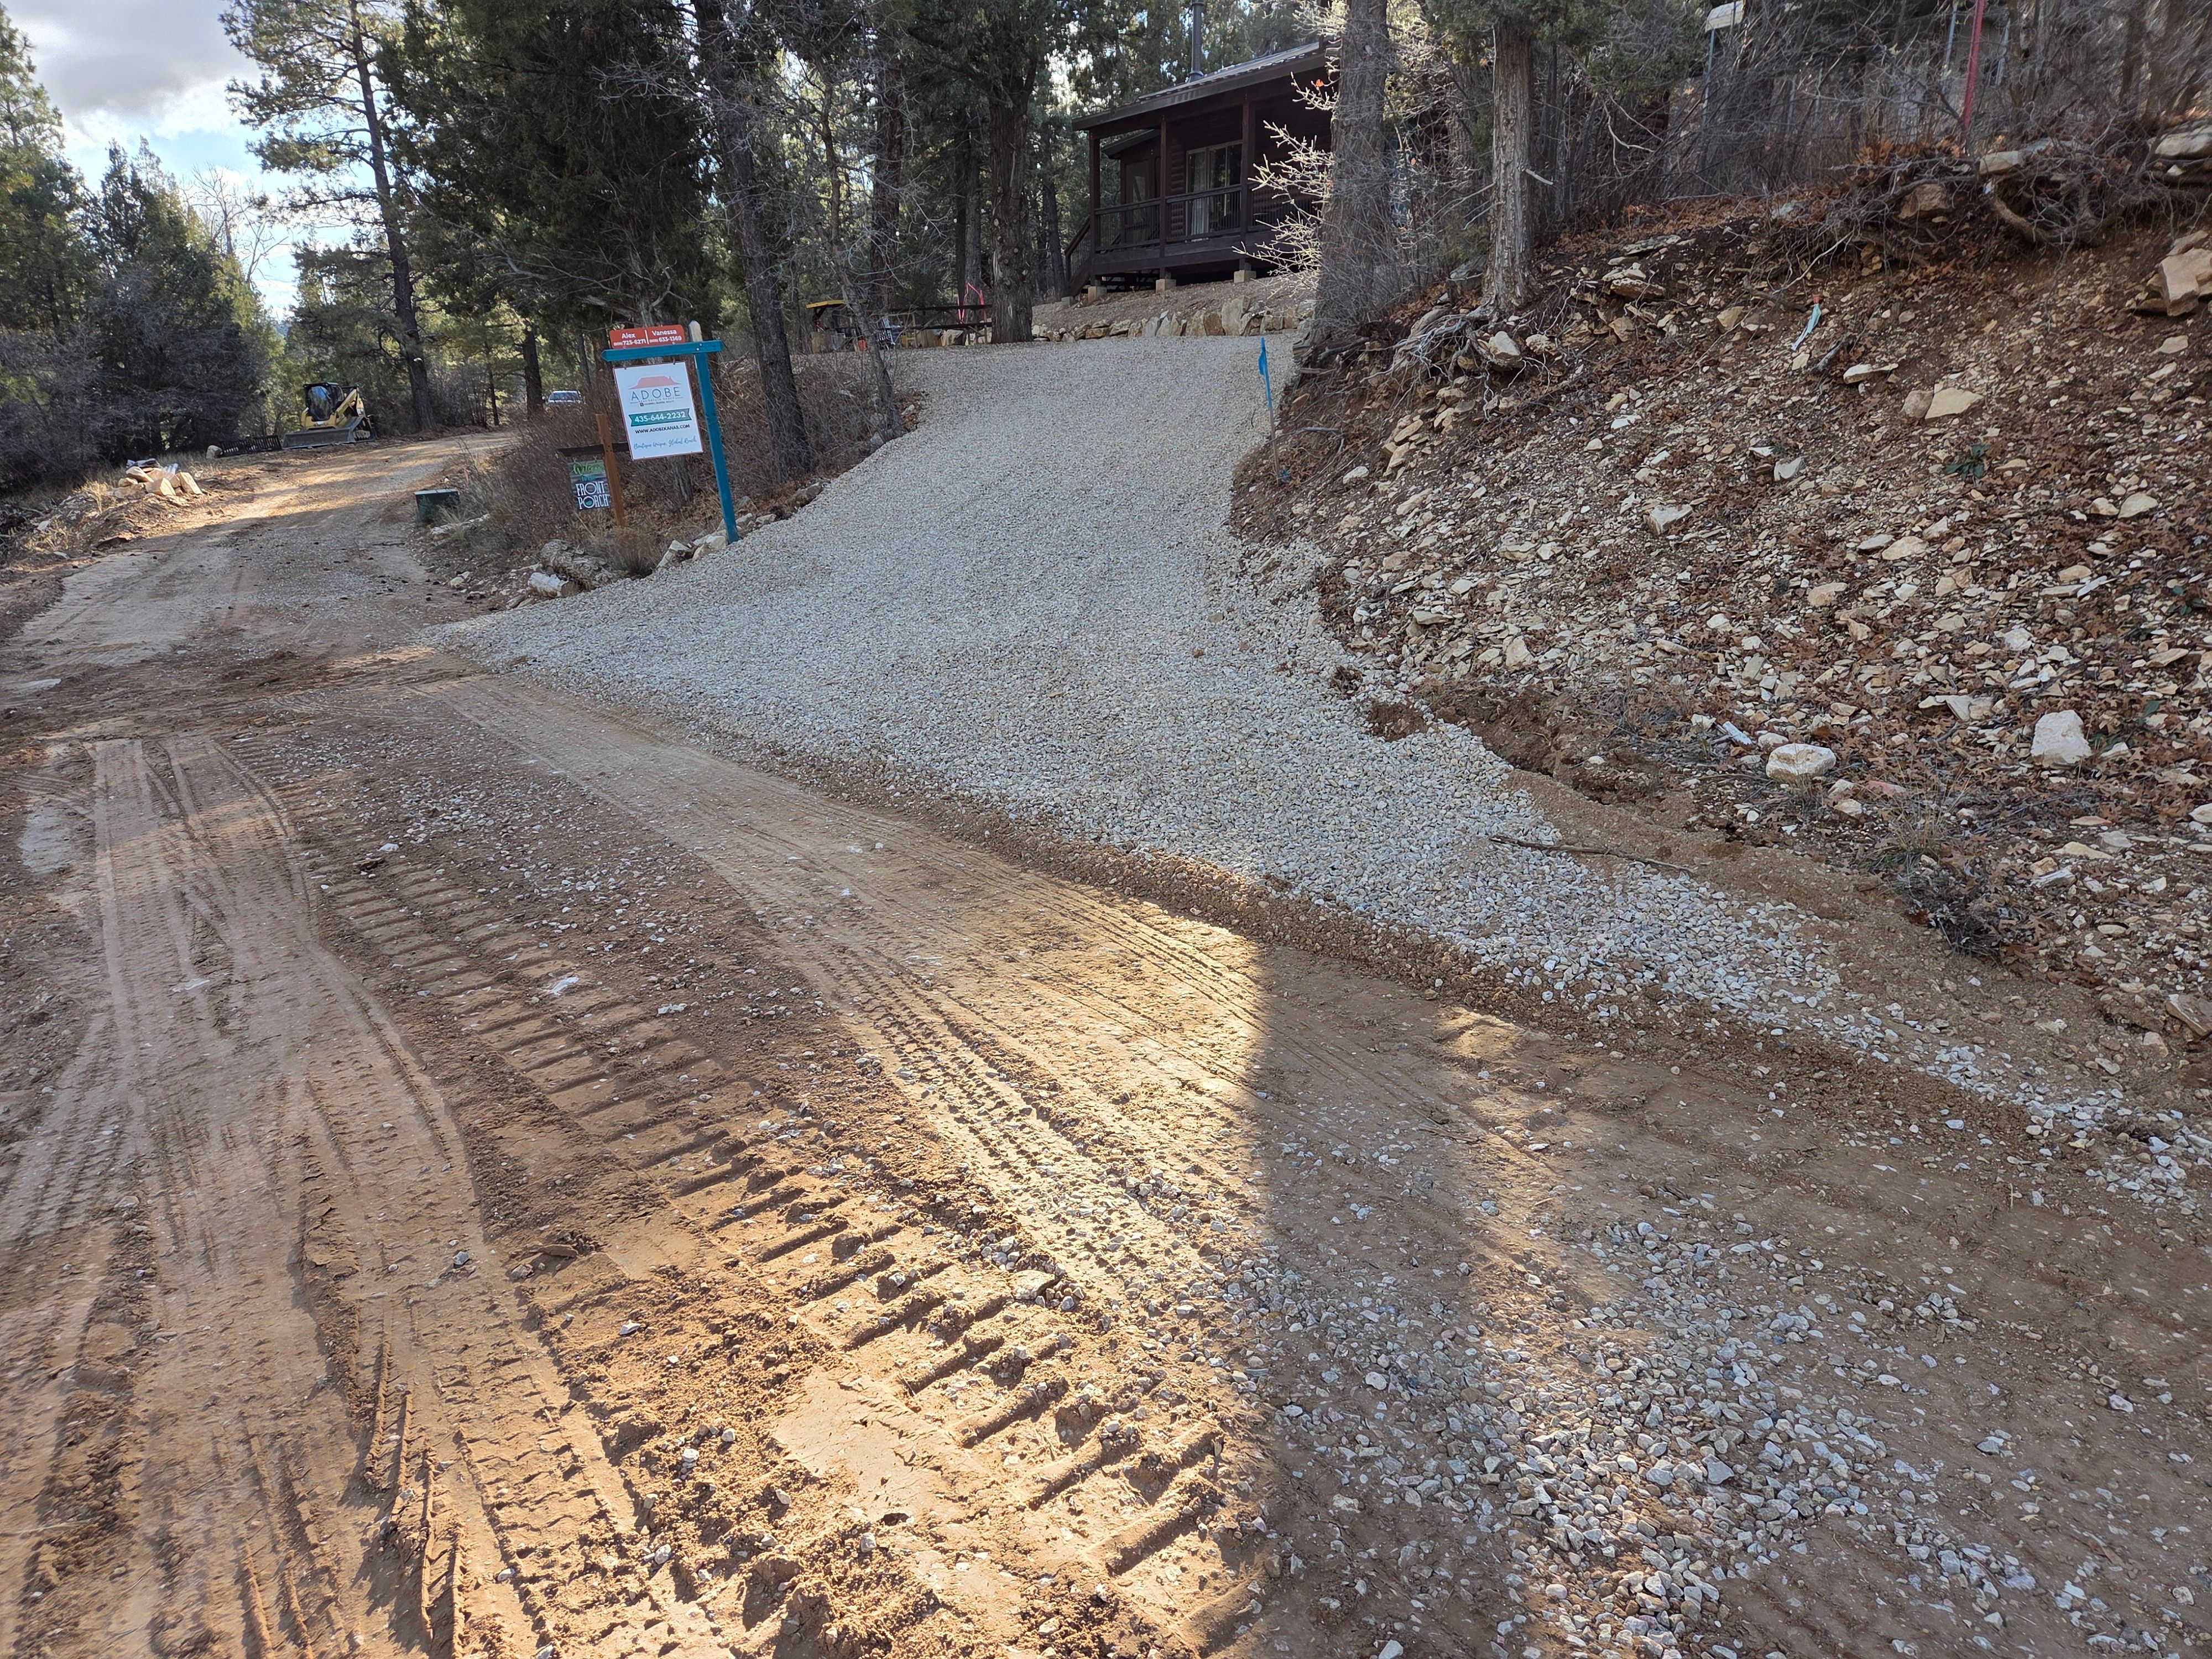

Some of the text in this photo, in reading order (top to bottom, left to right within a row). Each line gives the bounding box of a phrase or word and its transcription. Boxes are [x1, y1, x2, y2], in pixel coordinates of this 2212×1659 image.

[631, 387, 681, 401] ADOBE
[634, 411, 686, 423] 435-644-2232
[575, 481, 605, 496] FRONT
[577, 493, 609, 509] PORCH
